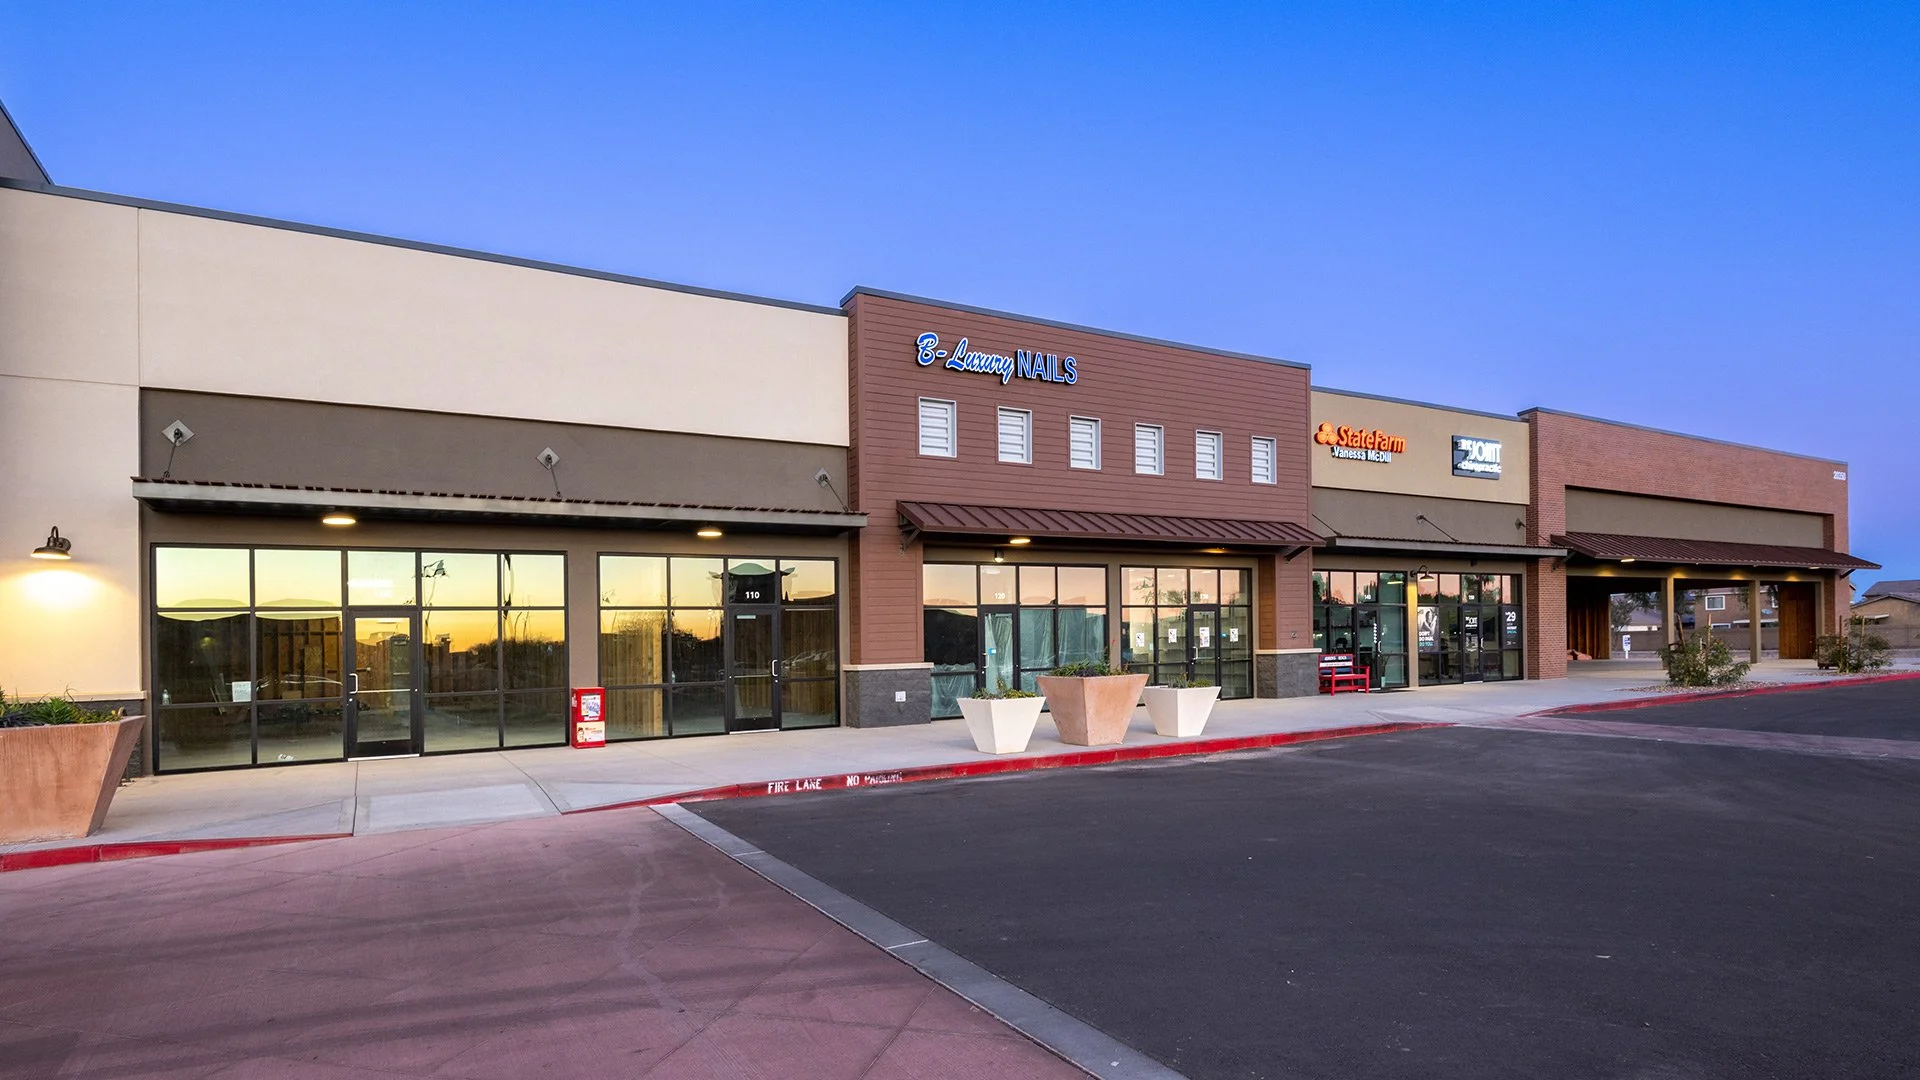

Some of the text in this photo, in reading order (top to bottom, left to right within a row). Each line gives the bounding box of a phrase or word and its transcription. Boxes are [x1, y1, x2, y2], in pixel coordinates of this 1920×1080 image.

[946, 337, 1015, 385] Luxury
[1017, 349, 1078, 385] NAILS
[745, 591, 760, 599] 110
[994, 592, 1006, 600] 120
[767, 781, 790, 794] FIRE
[796, 778, 822, 791] LANE
[846, 775, 860, 787] NO
